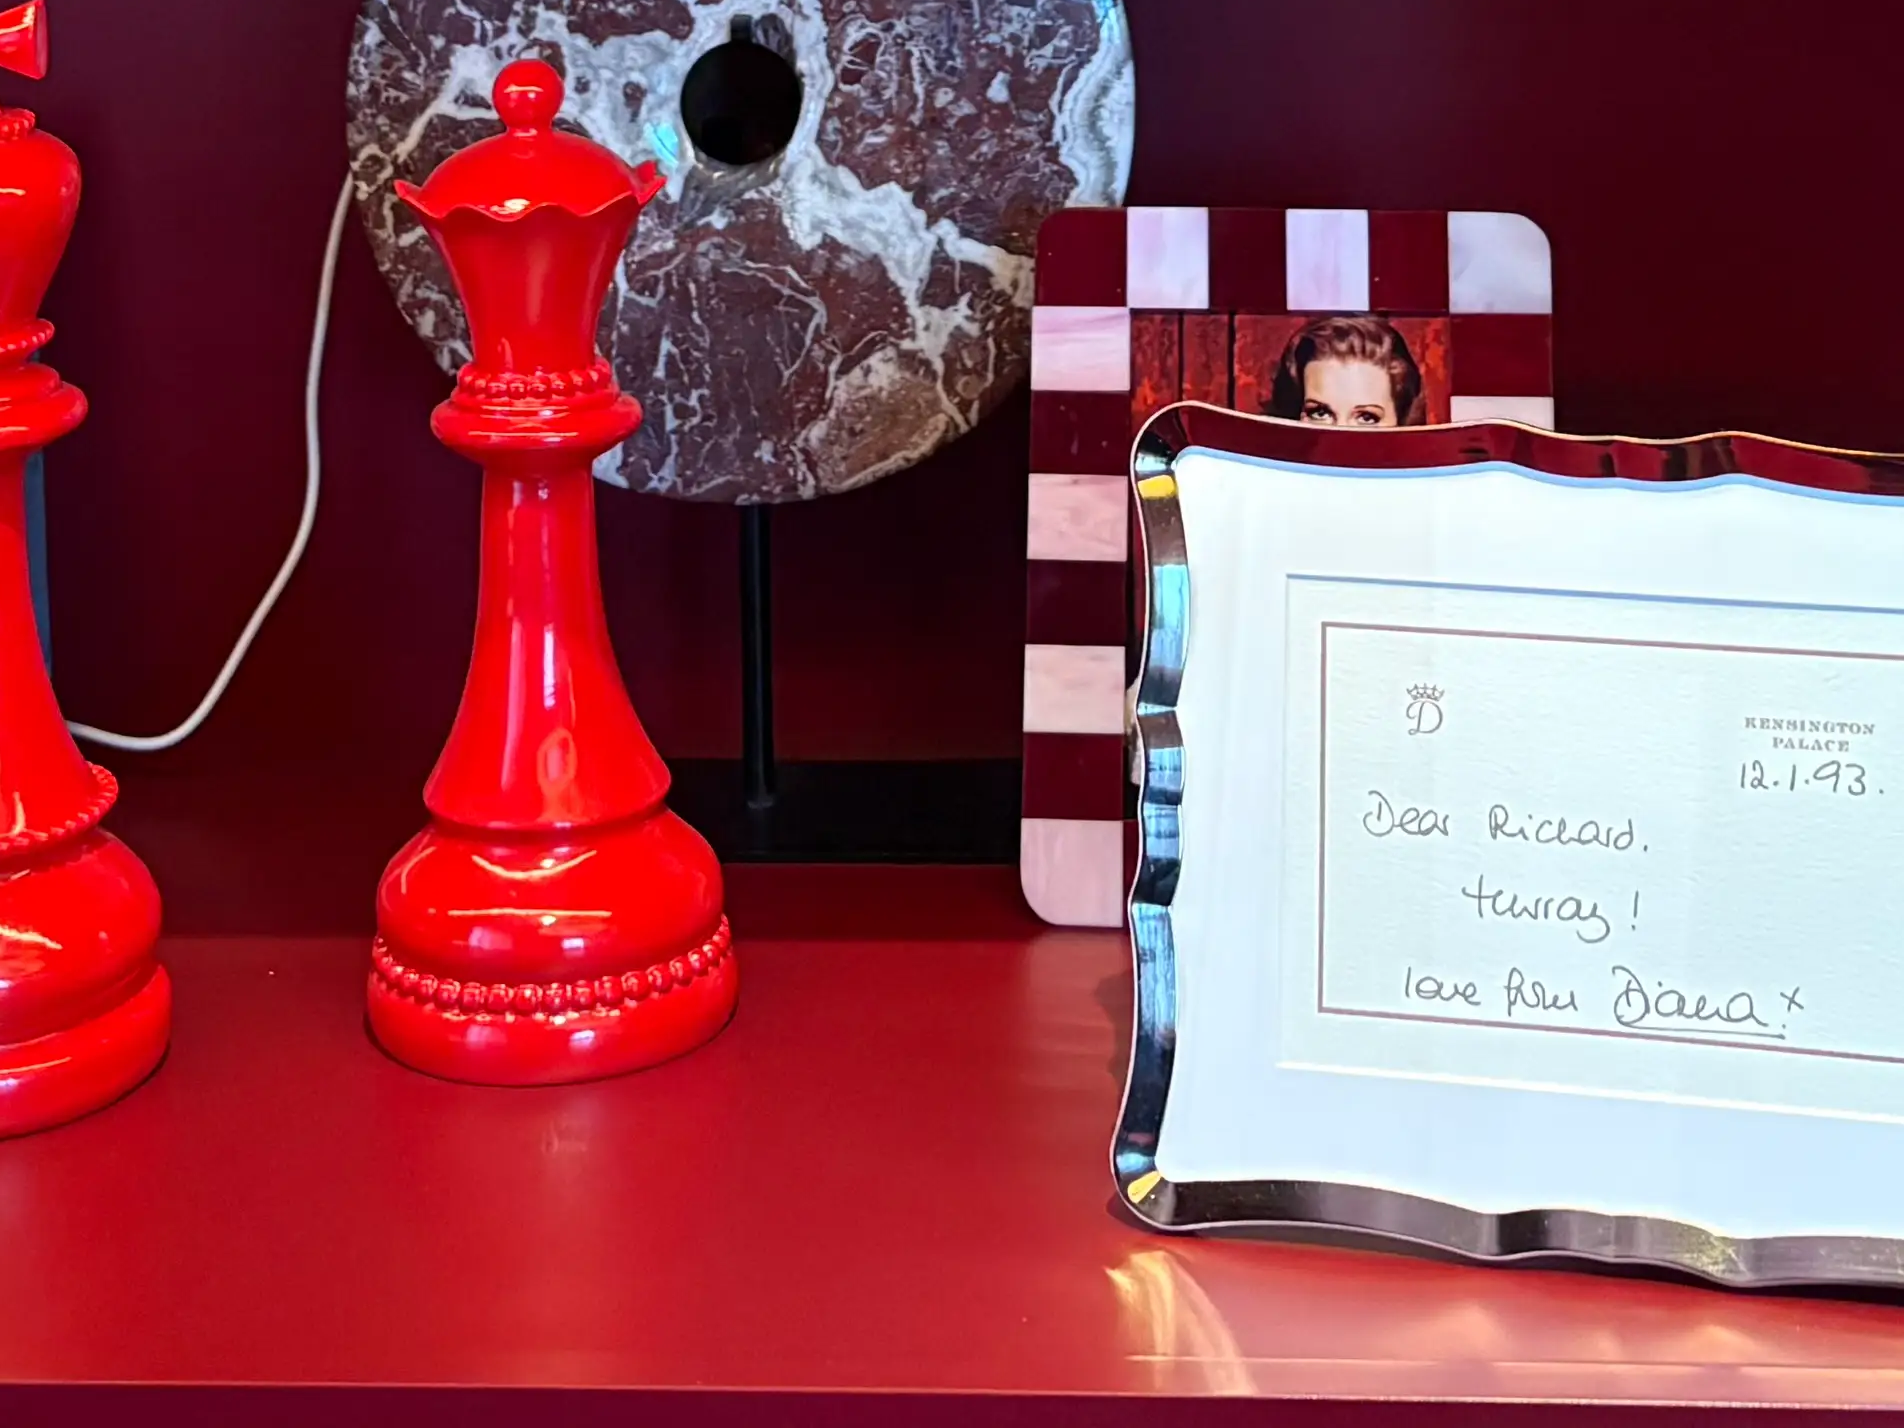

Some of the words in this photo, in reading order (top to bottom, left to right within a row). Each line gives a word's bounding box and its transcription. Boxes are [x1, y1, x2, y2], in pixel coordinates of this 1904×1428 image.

[1744, 716, 1876, 736] KENSINGTON
[1772, 736, 1850, 753] PALACE
[1362, 789, 1450, 837] Dear
[1503, 966, 1579, 1017] from
